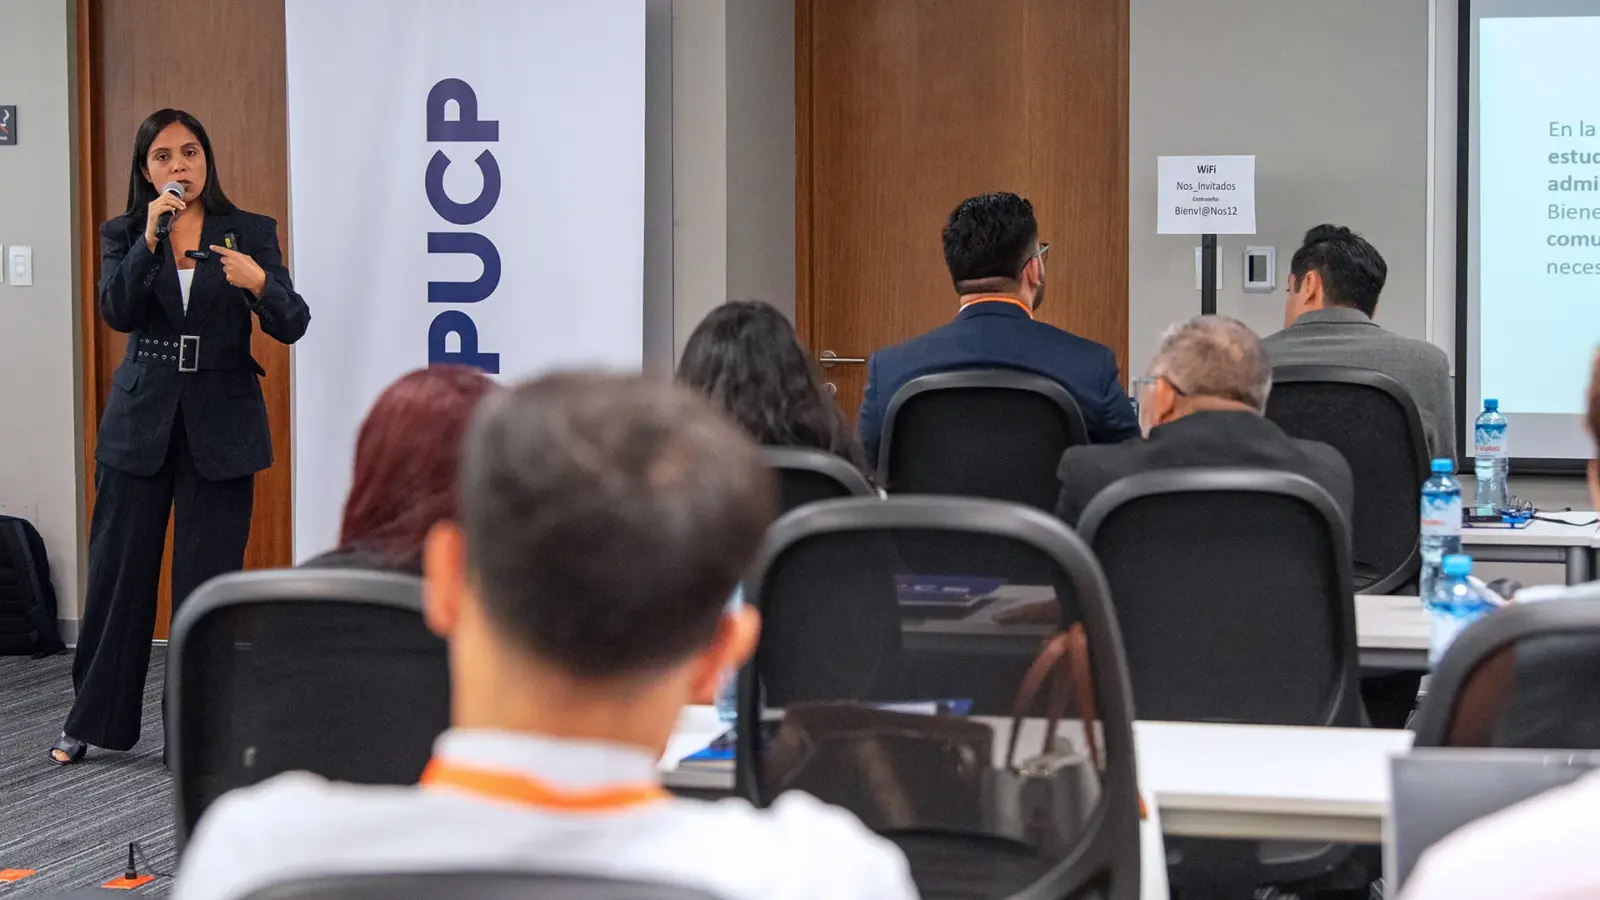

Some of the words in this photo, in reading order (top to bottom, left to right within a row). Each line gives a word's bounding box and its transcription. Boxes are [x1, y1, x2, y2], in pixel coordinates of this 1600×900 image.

[1549, 121, 1573, 138] En
[1579, 120, 1597, 138] la
[1196, 165, 1216, 174] WiFi
[1176, 181, 1236, 193] Nos_Invitados
[1174, 206, 1238, 217] Bienv!@Nos12
[1547, 203, 1600, 220] Biene
[425, 78, 501, 374] PUCP
